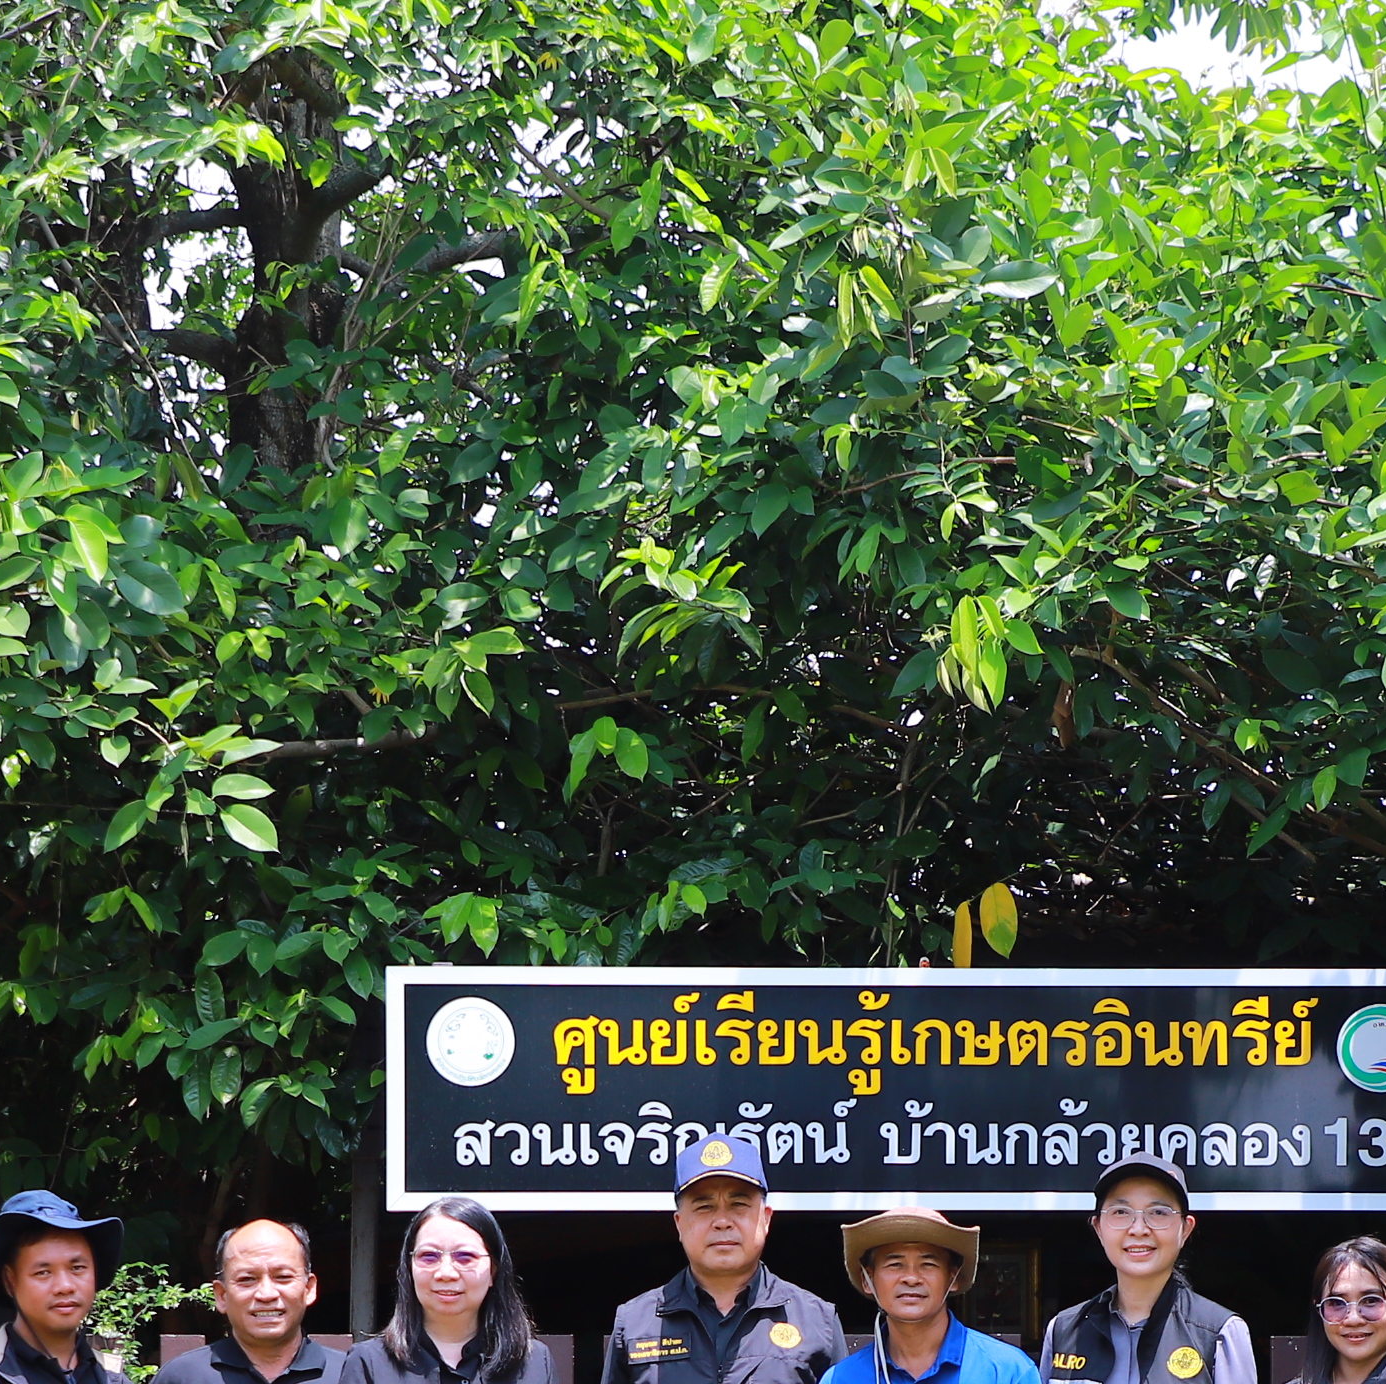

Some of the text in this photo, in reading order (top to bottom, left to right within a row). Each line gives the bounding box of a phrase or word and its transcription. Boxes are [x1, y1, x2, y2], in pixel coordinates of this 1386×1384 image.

[553, 990, 1319, 1095] ศูนย์เรียนรู้เกษตรอินทรีย์
[1052, 1352, 1087, 1370] ALRO
